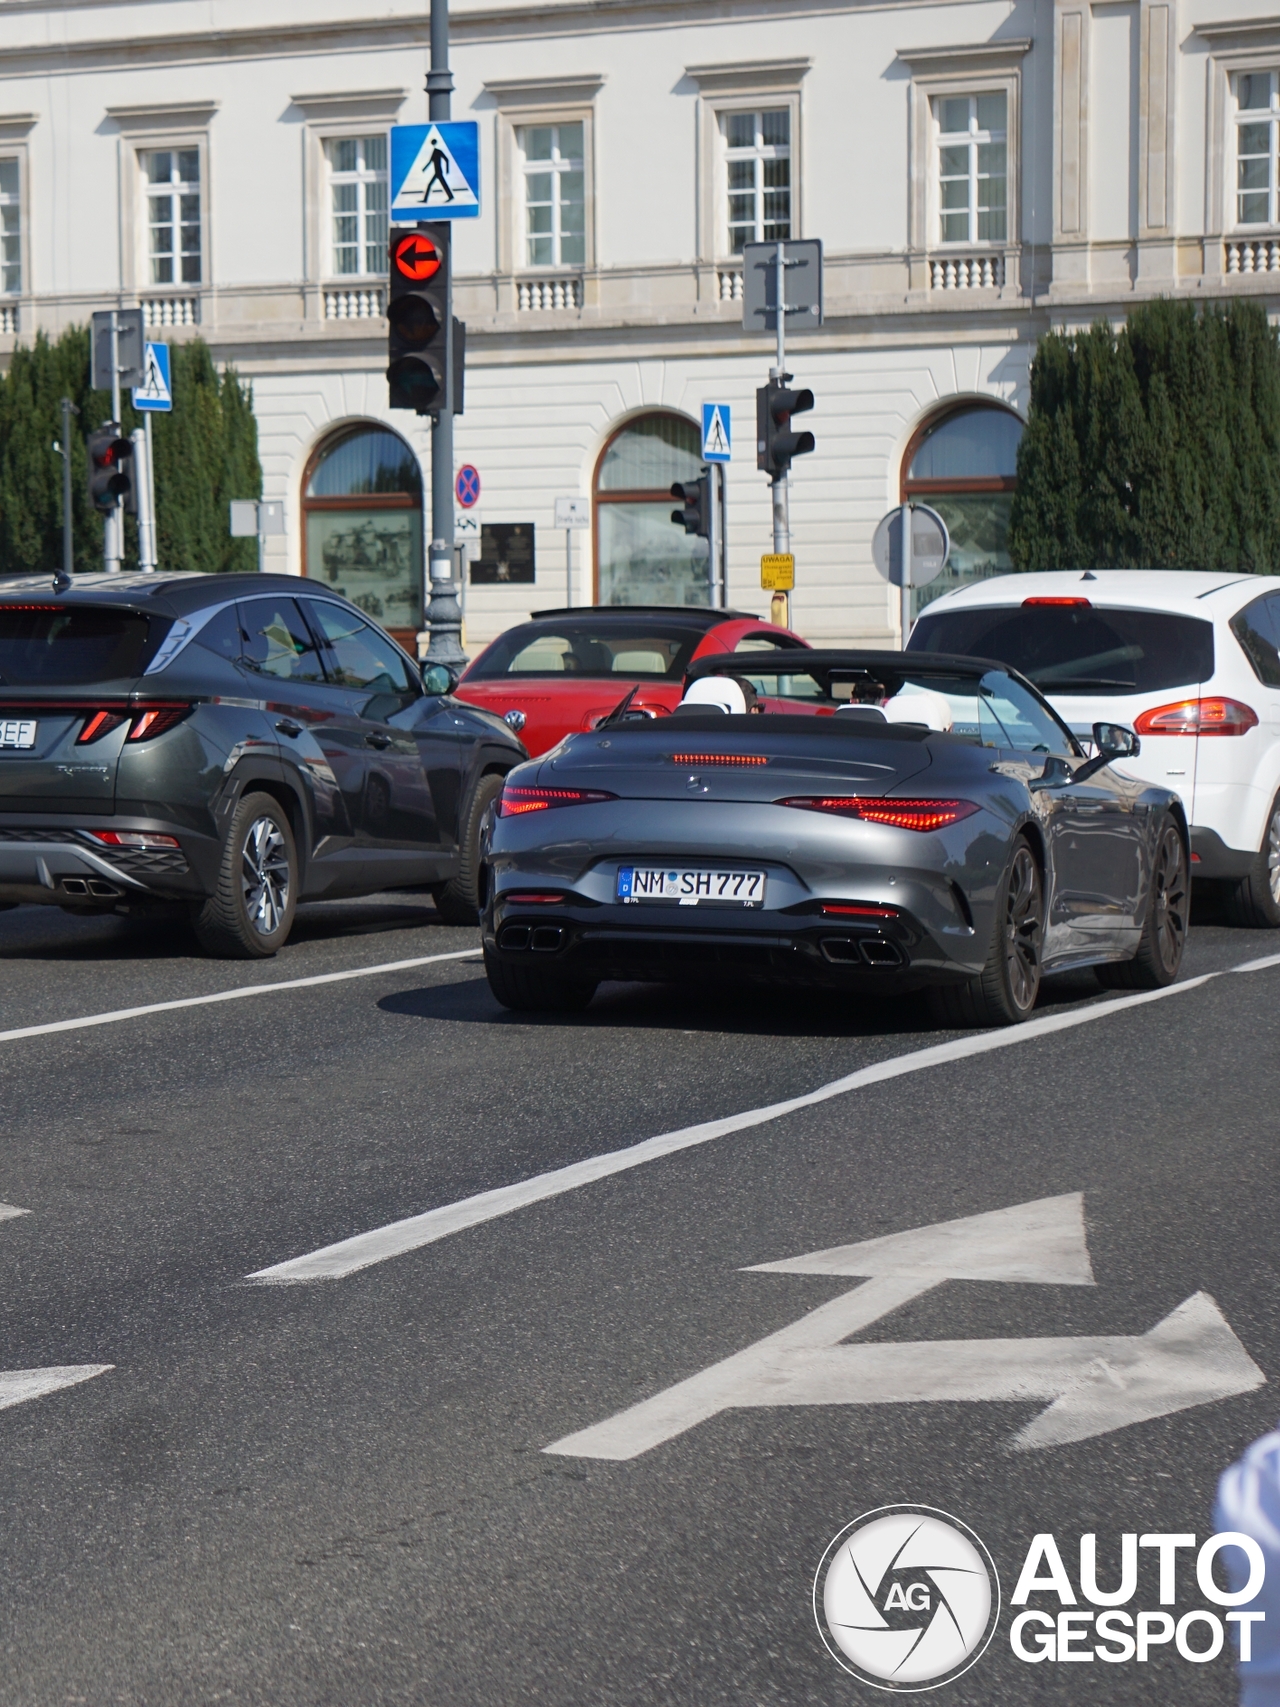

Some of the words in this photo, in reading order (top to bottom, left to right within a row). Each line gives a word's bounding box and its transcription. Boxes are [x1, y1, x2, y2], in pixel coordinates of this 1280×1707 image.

[634, 871, 665, 893] NM
[680, 872, 710, 895] SH
[717, 873, 761, 896] 777
